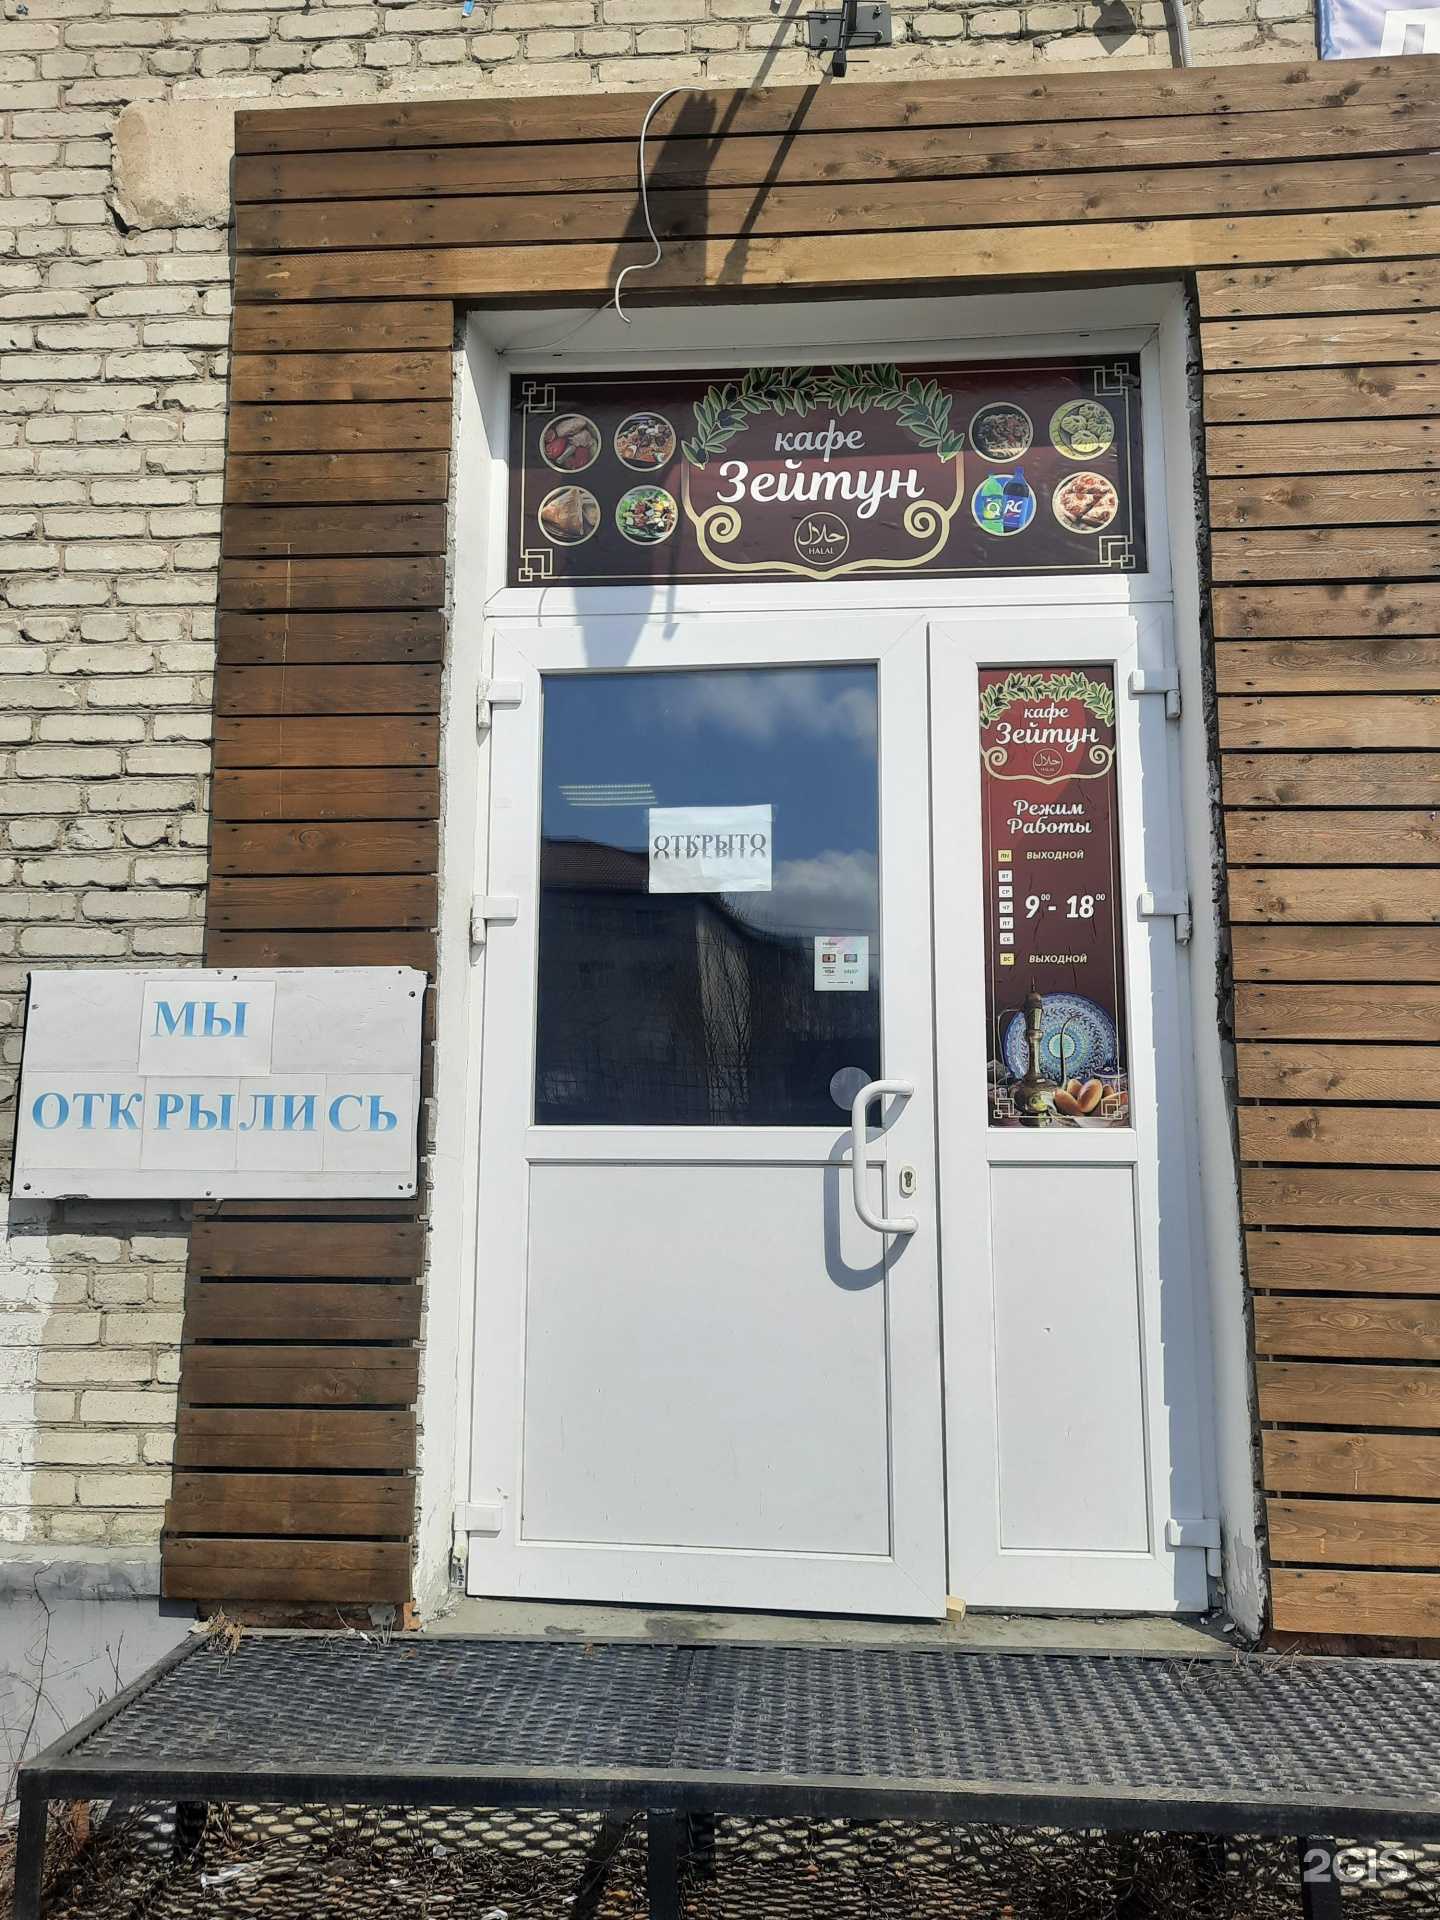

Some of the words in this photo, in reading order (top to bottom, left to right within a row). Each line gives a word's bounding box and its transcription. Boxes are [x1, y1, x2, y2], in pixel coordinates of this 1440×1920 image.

[774, 419, 865, 462] кафе
[716, 458, 925, 519] Зейтун
[808, 547, 834, 555] HALAL
[1024, 702, 1070, 724] кафе
[995, 721, 1100, 753] Зейтун
[1013, 799, 1085, 816] Режим
[1007, 816, 1092, 834] Работы
[653, 833, 767, 857] ОТКРЫТО
[1026, 849, 1084, 860] ВЫХОДНОЙ
[1029, 953, 1087, 964] ВЫХОДНОЙ
[151, 1000, 250, 1038] МЫ
